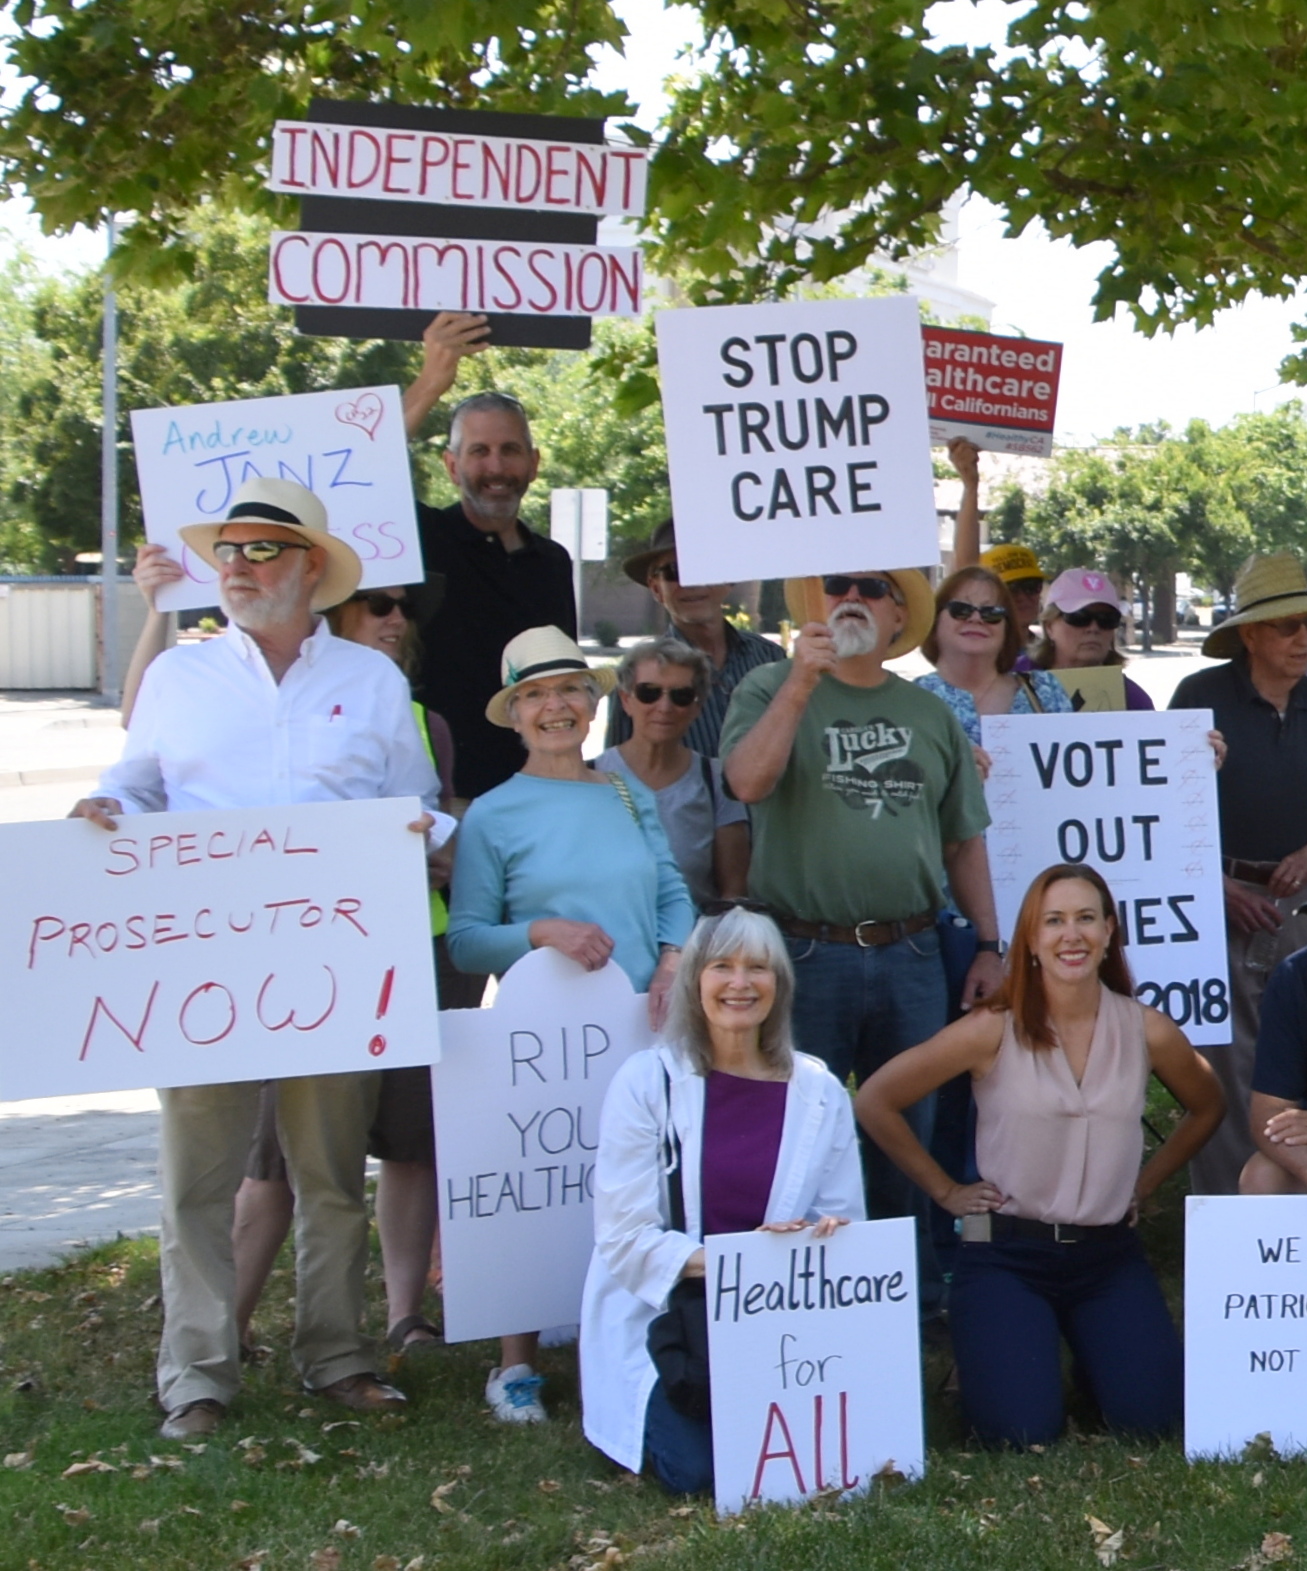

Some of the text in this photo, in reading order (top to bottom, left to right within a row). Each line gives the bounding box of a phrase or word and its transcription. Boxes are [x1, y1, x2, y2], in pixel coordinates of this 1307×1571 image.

[279, 127, 645, 209] INDEPENDENT
[272, 235, 641, 313] COMMISSION
[720, 329, 858, 389] STOP
[924, 339, 1055, 373] aranteed
[926, 364, 1052, 401] althcare
[702, 393, 890, 456] TRUMP
[941, 395, 1049, 422] Californians
[162, 420, 294, 455] Andrew
[730, 461, 882, 522] CARE
[824, 722, 912, 773] Lucky
[1029, 739, 1168, 789] VOTE
[822, 773, 925, 791] FISHING SHIRT
[865, 798, 883, 819] 7
[105, 826, 319, 877] SPECIAL
[1057, 815, 1160, 864] OUT
[27, 898, 369, 970] PROSECUTOR
[1136, 977, 1229, 1027] 2018
[510, 1023, 611, 1087] RIP
[1258, 1237, 1301, 1263] WE
[713, 1244, 908, 1322] Healthcare
[773, 1333, 843, 1389] for
[1250, 1349, 1300, 1372] NOT
[751, 1391, 859, 1500] All
